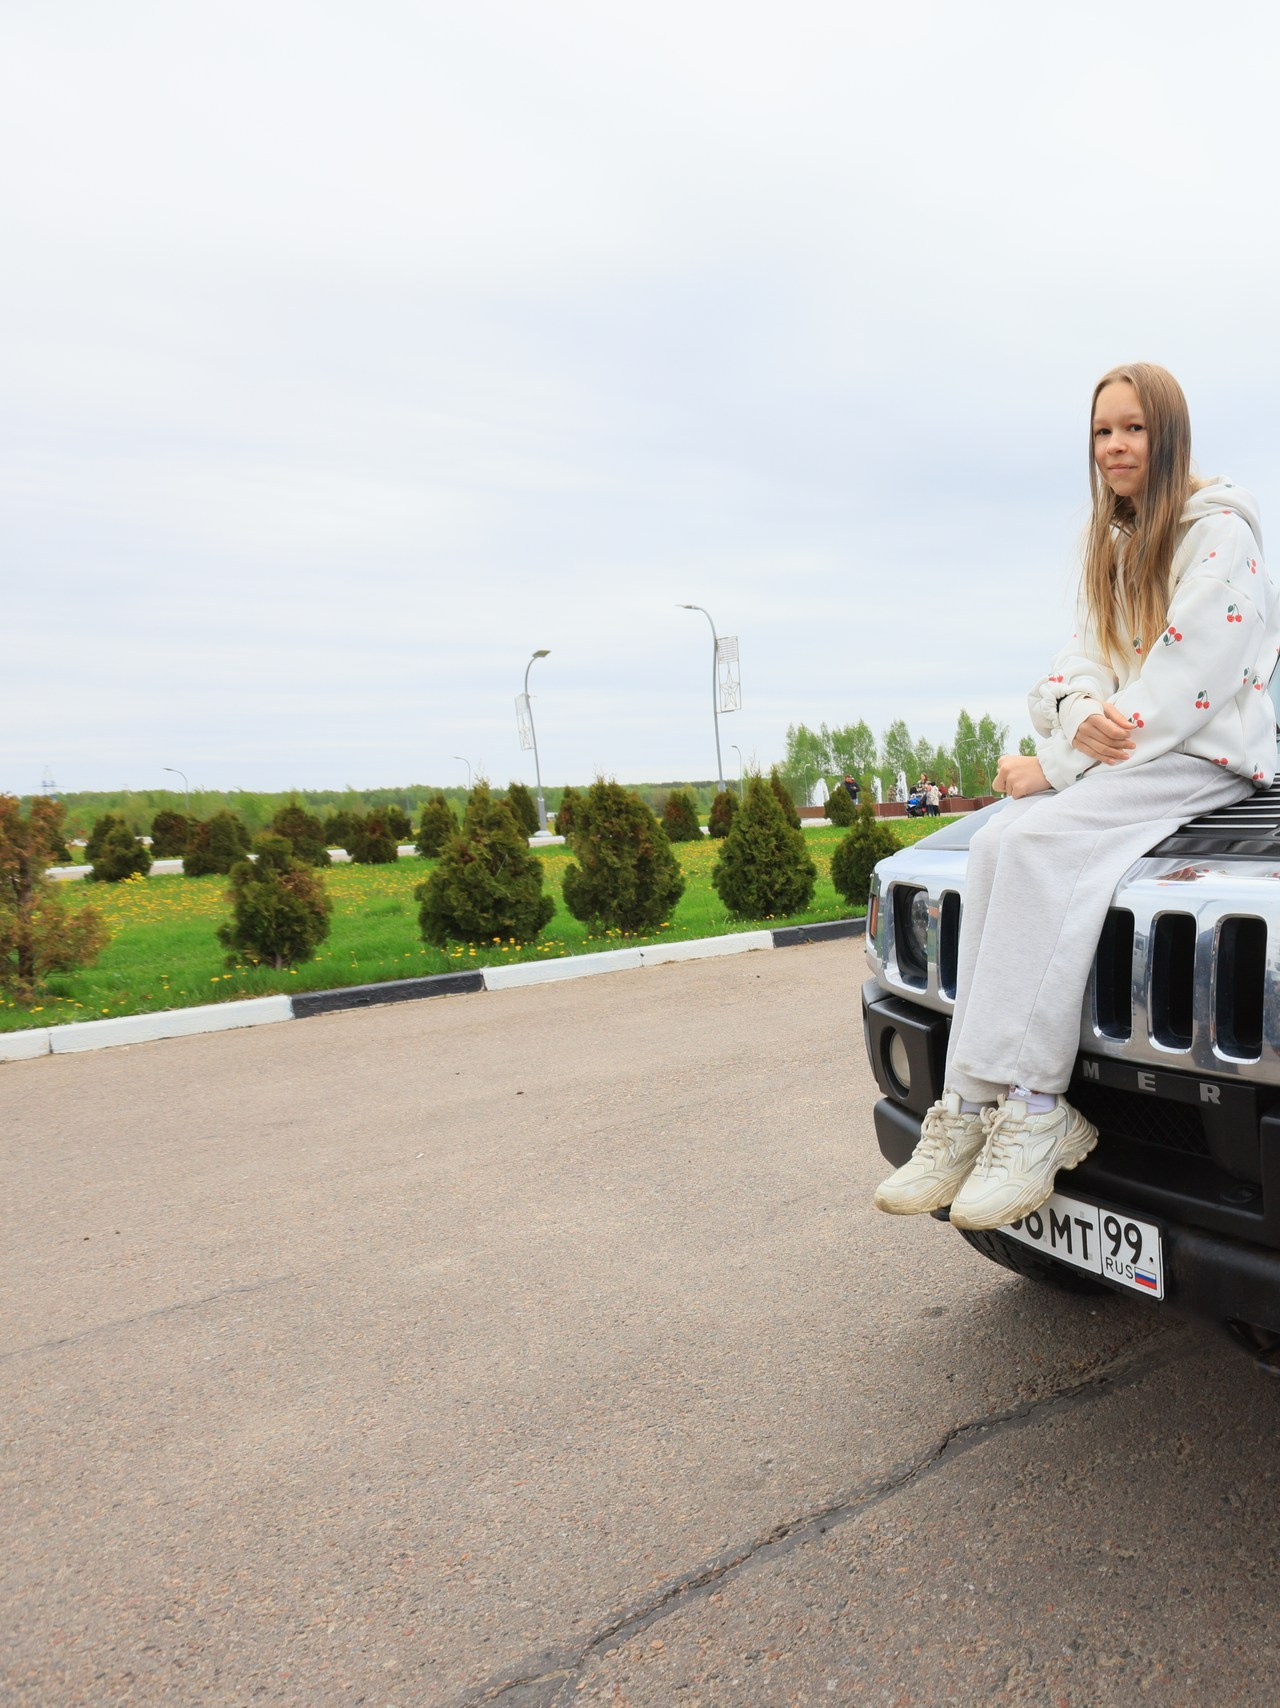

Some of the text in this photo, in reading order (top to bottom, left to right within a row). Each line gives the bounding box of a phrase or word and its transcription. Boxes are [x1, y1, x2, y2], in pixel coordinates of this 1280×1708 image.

[1082, 1060, 1221, 1104] MER
[1104, 1215, 1142, 1265] 99
[1106, 1256, 1133, 1279] RUS
